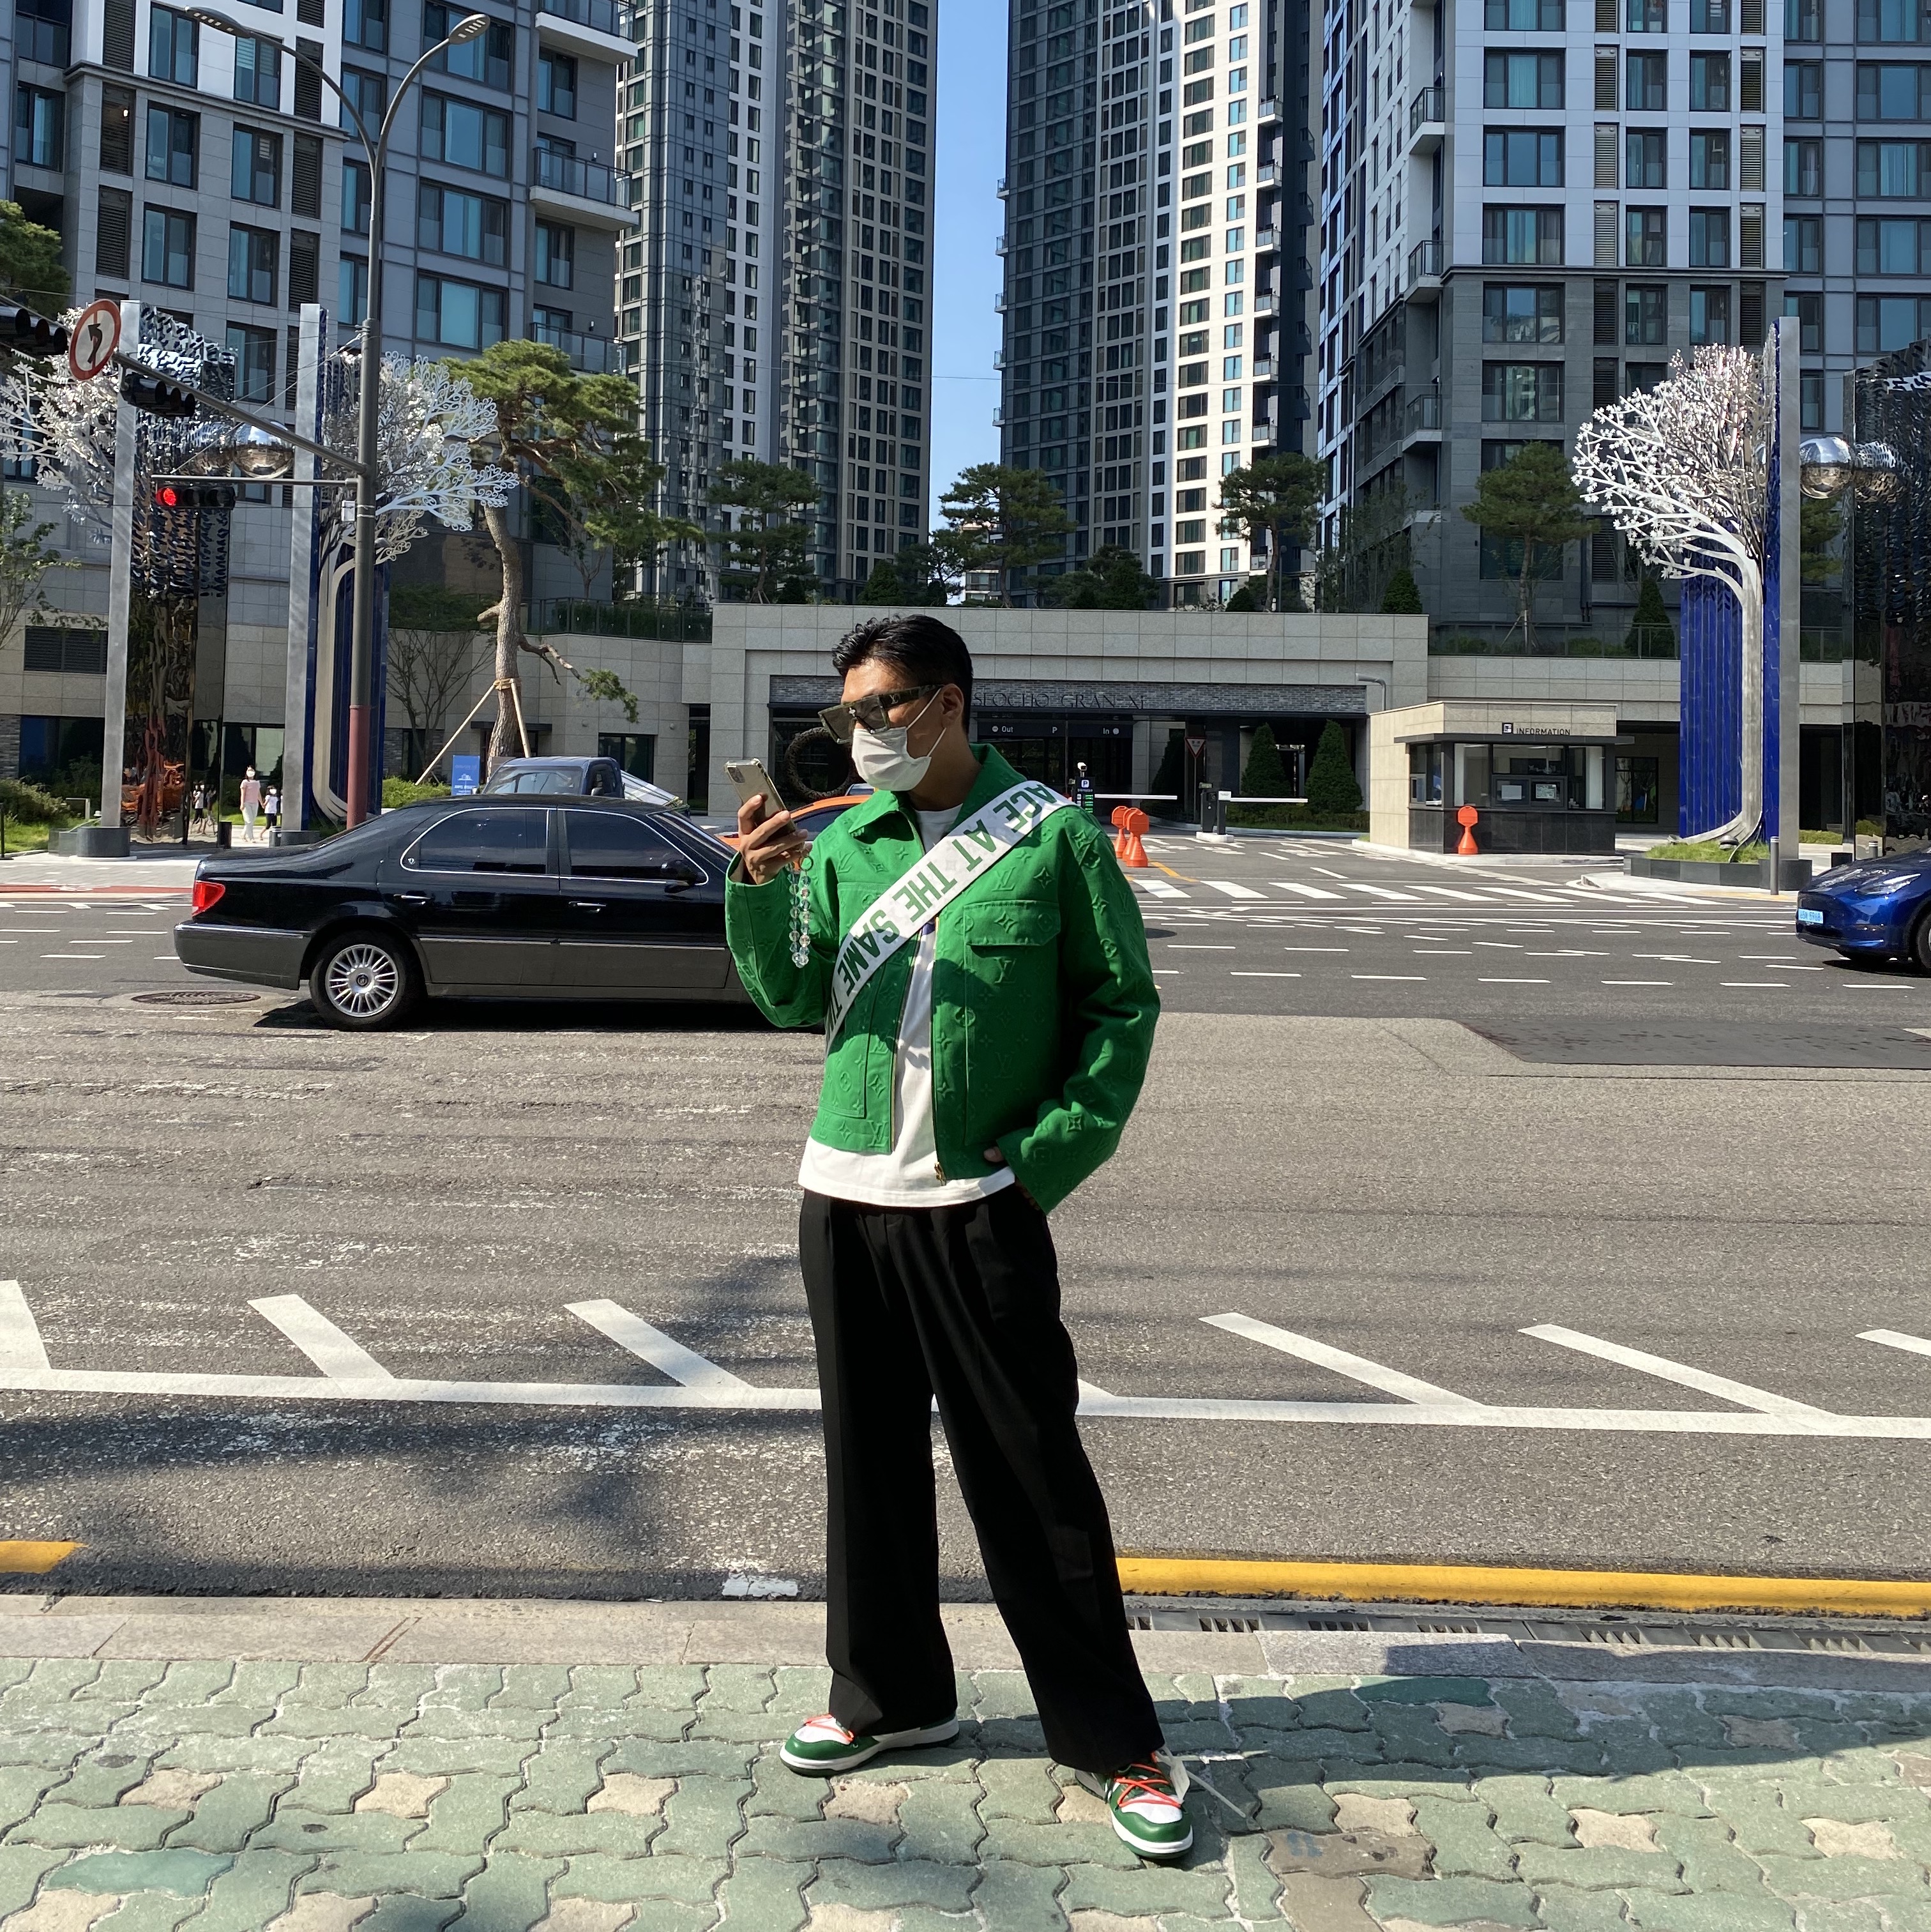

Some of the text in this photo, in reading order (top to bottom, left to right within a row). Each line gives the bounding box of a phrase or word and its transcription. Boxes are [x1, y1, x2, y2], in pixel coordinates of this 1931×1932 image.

[1061, 694, 1116, 708] GRAN
[951, 819, 997, 872] AT
[891, 861, 958, 923] THE
[837, 909, 900, 997] SAME
